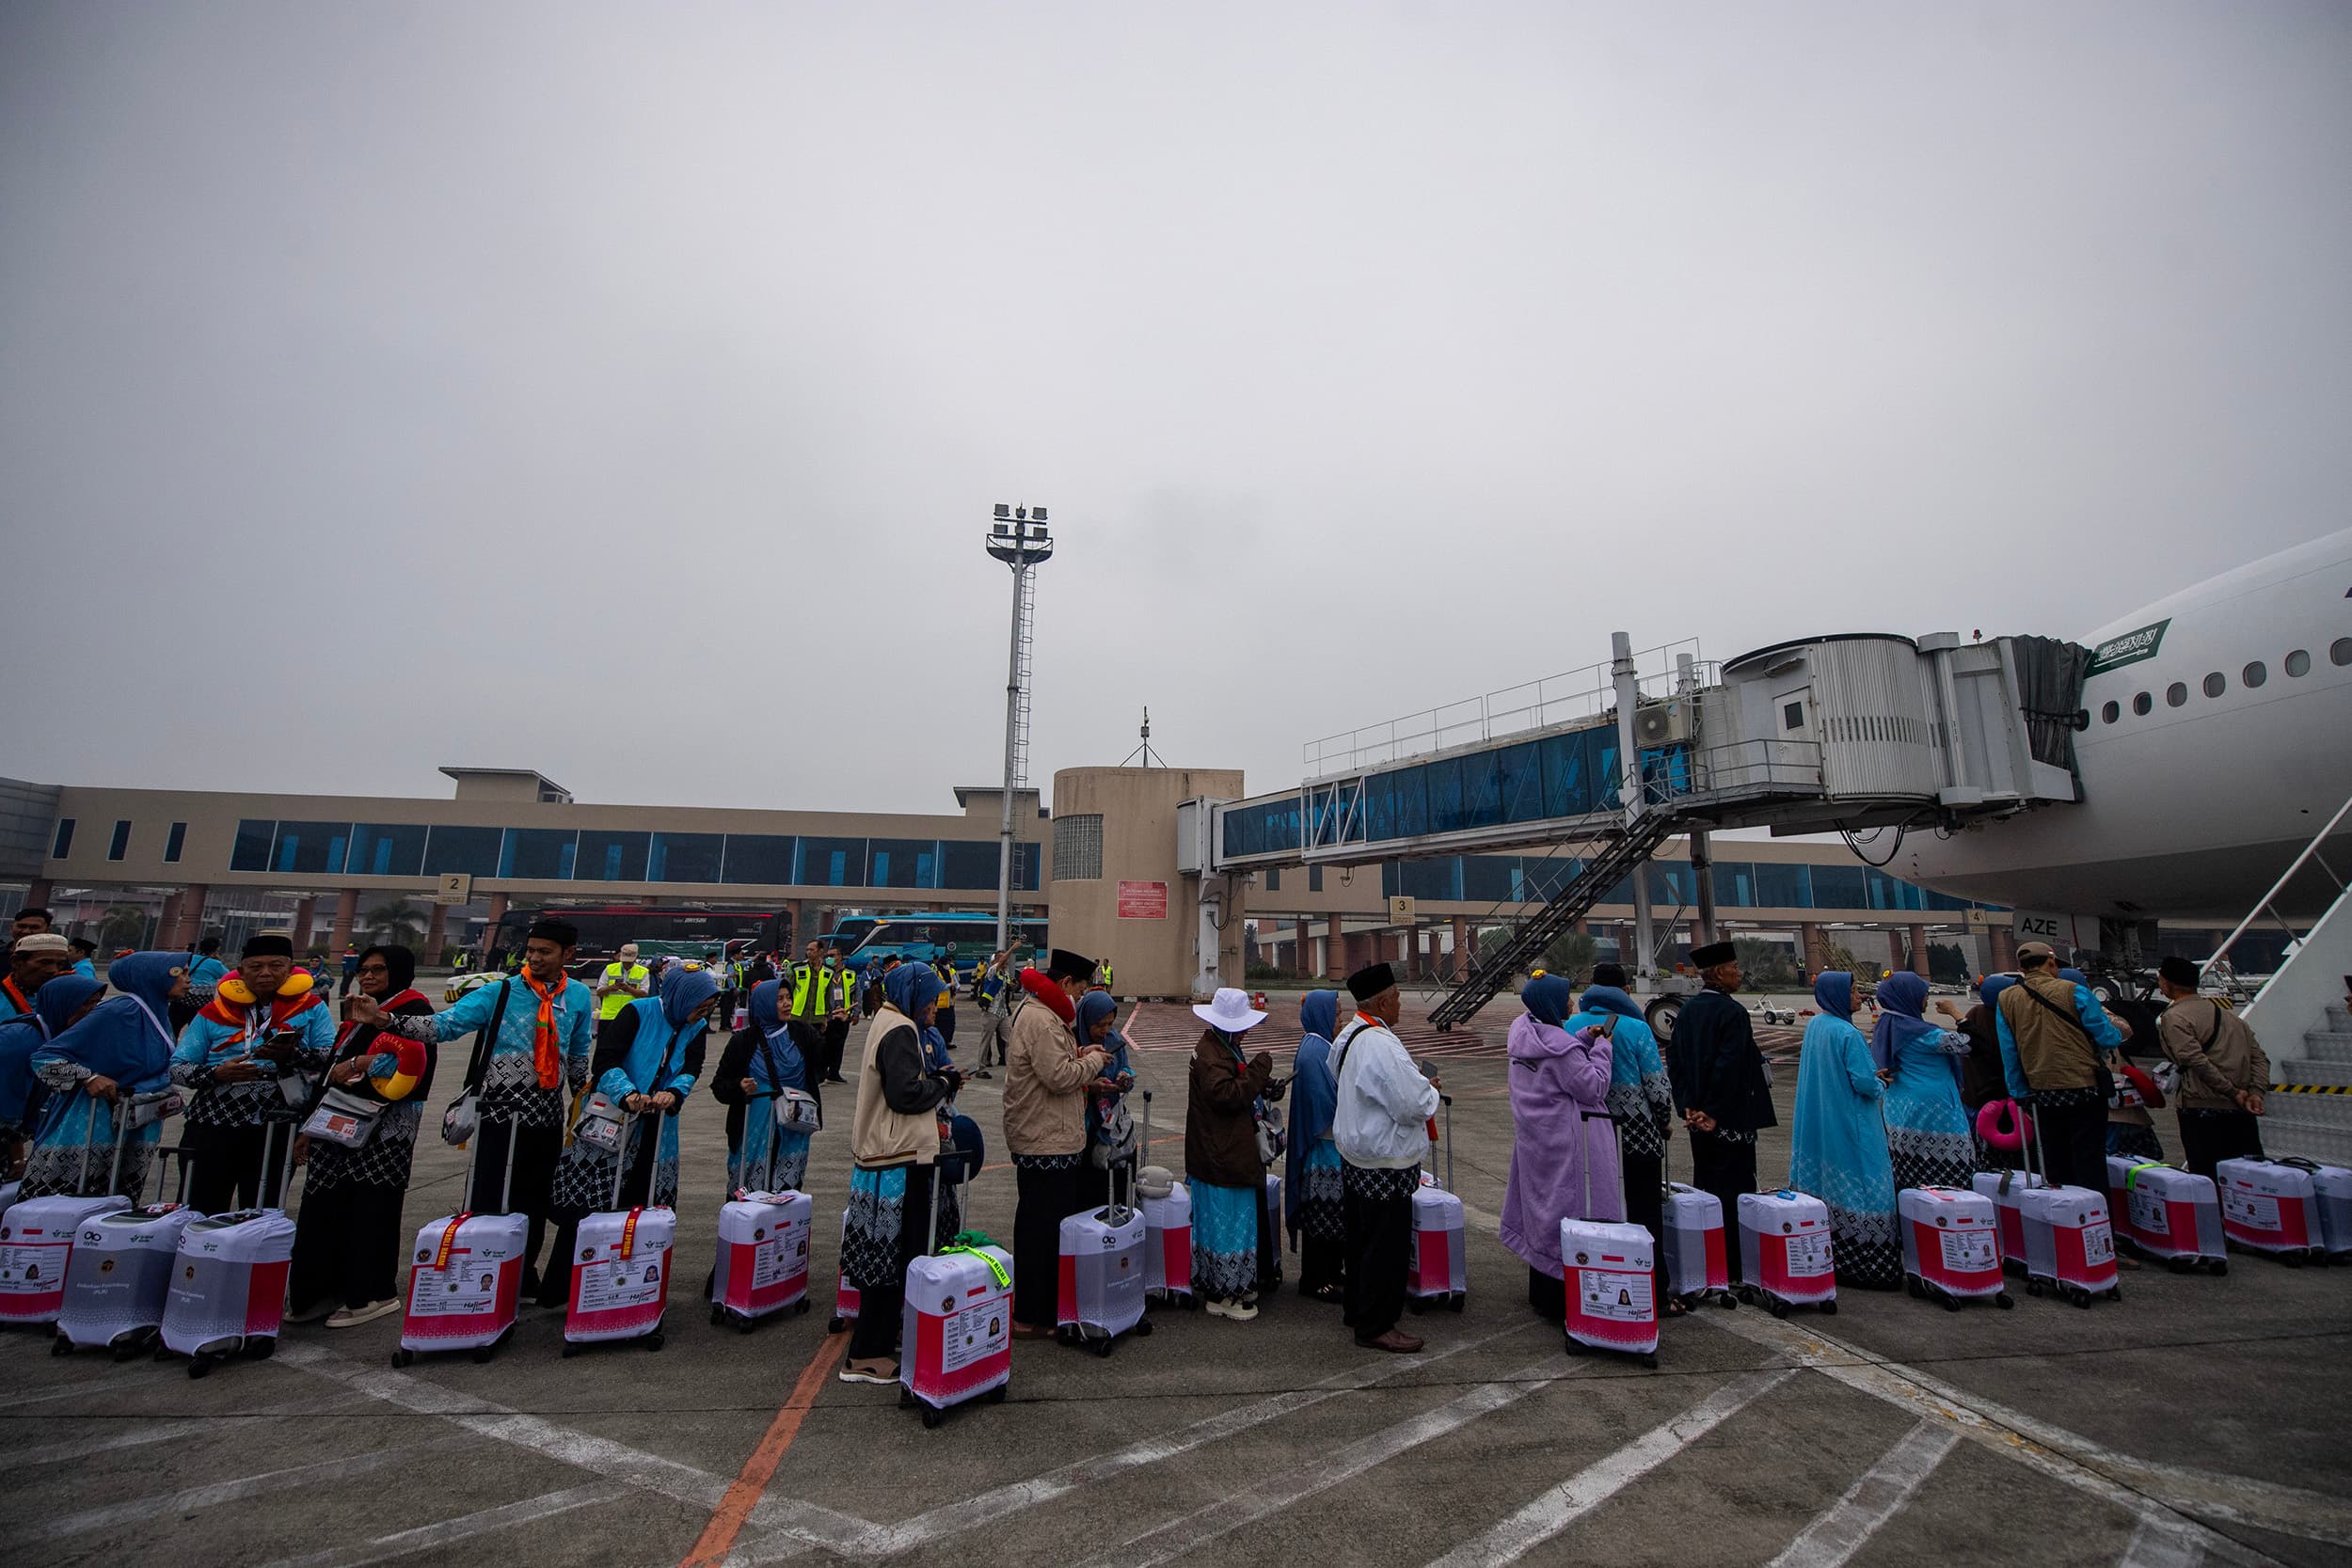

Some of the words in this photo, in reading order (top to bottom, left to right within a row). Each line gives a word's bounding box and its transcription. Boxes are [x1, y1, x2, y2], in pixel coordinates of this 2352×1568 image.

[450, 878, 459, 890] 2
[1399, 900, 1406, 911] 3
[1973, 912, 1979, 922] 4
[2022, 917, 2058, 937] AZE
